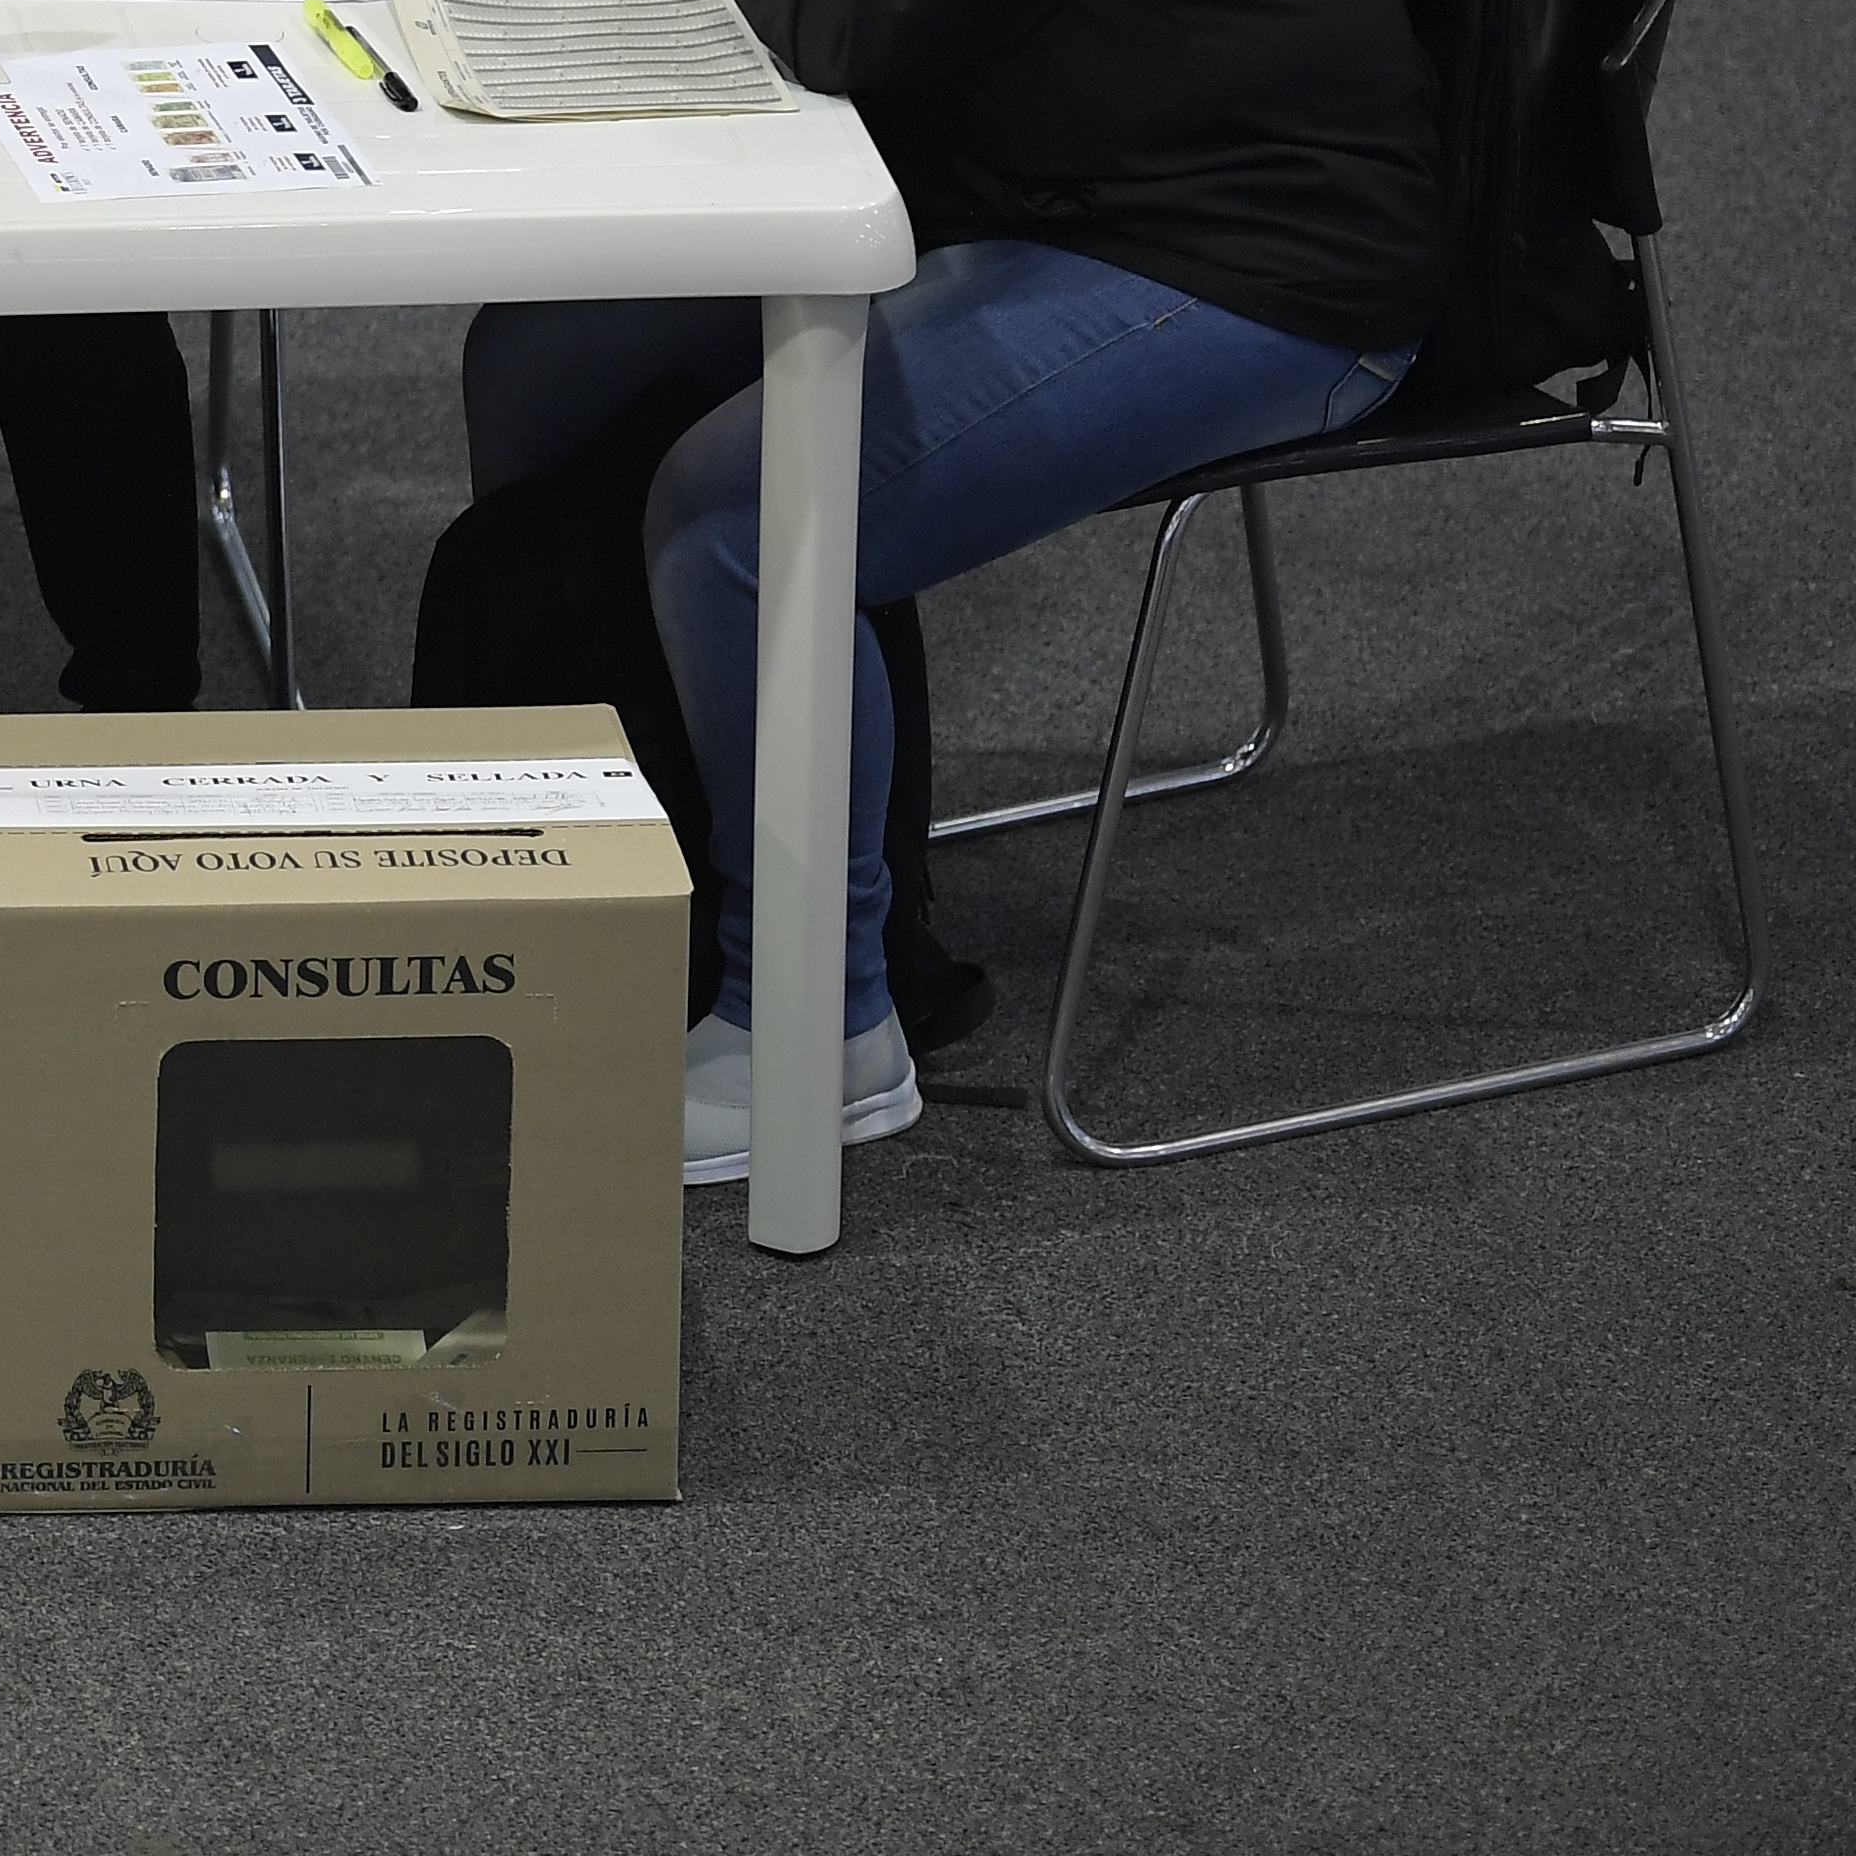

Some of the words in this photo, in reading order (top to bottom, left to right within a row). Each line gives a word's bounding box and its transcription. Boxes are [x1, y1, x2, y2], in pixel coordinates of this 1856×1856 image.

[29, 778, 128, 789] URNA
[162, 774, 332, 788] CERRADA
[367, 773, 390, 784] Y
[426, 771, 588, 783] SELLADA
[89, 853, 183, 878] AQUÍ
[196, 850, 304, 872] VOTO
[315, 849, 361, 870] SU
[375, 848, 572, 869] DEPOSITE
[163, 953, 516, 1001] CONSULTAS
[381, 1411, 409, 1434] LA
[429, 1403, 651, 1432] REGISTRADURÍA
[381, 1441, 430, 1468] DEL
[436, 1439, 515, 1468] SIGLO
[527, 1438, 571, 1466] XXI
[0, 1453, 217, 1480] REGISTRADURÍA
[0, 1480, 76, 1493] NACIONAL
[80, 1480, 110, 1493] DEL
[115, 1479, 174, 1491] ESTADO
[178, 1478, 217, 1491] CIVIL
